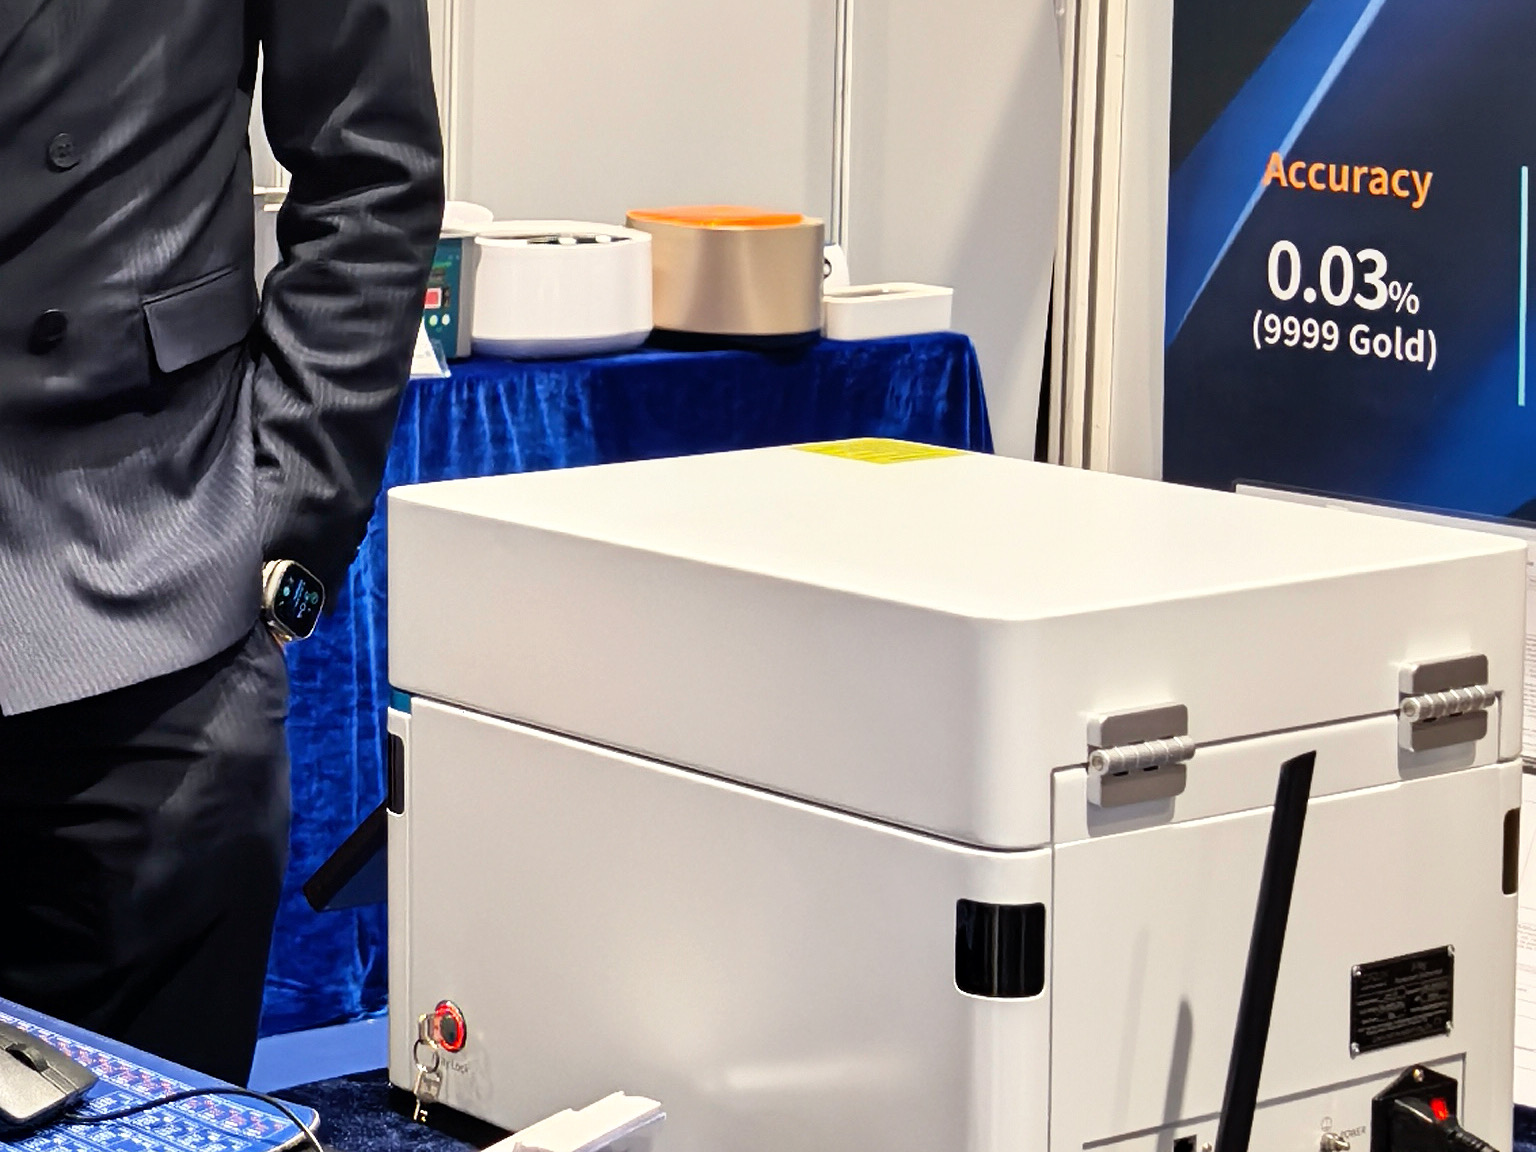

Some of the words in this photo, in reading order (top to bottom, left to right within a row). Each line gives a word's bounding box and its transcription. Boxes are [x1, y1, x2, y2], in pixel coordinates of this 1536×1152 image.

[1263, 151, 1434, 209] Accuracy
[1267, 239, 1420, 315] 0.03%
[1252, 309, 1340, 351] (9999
[1349, 323, 1438, 371] Gold)
